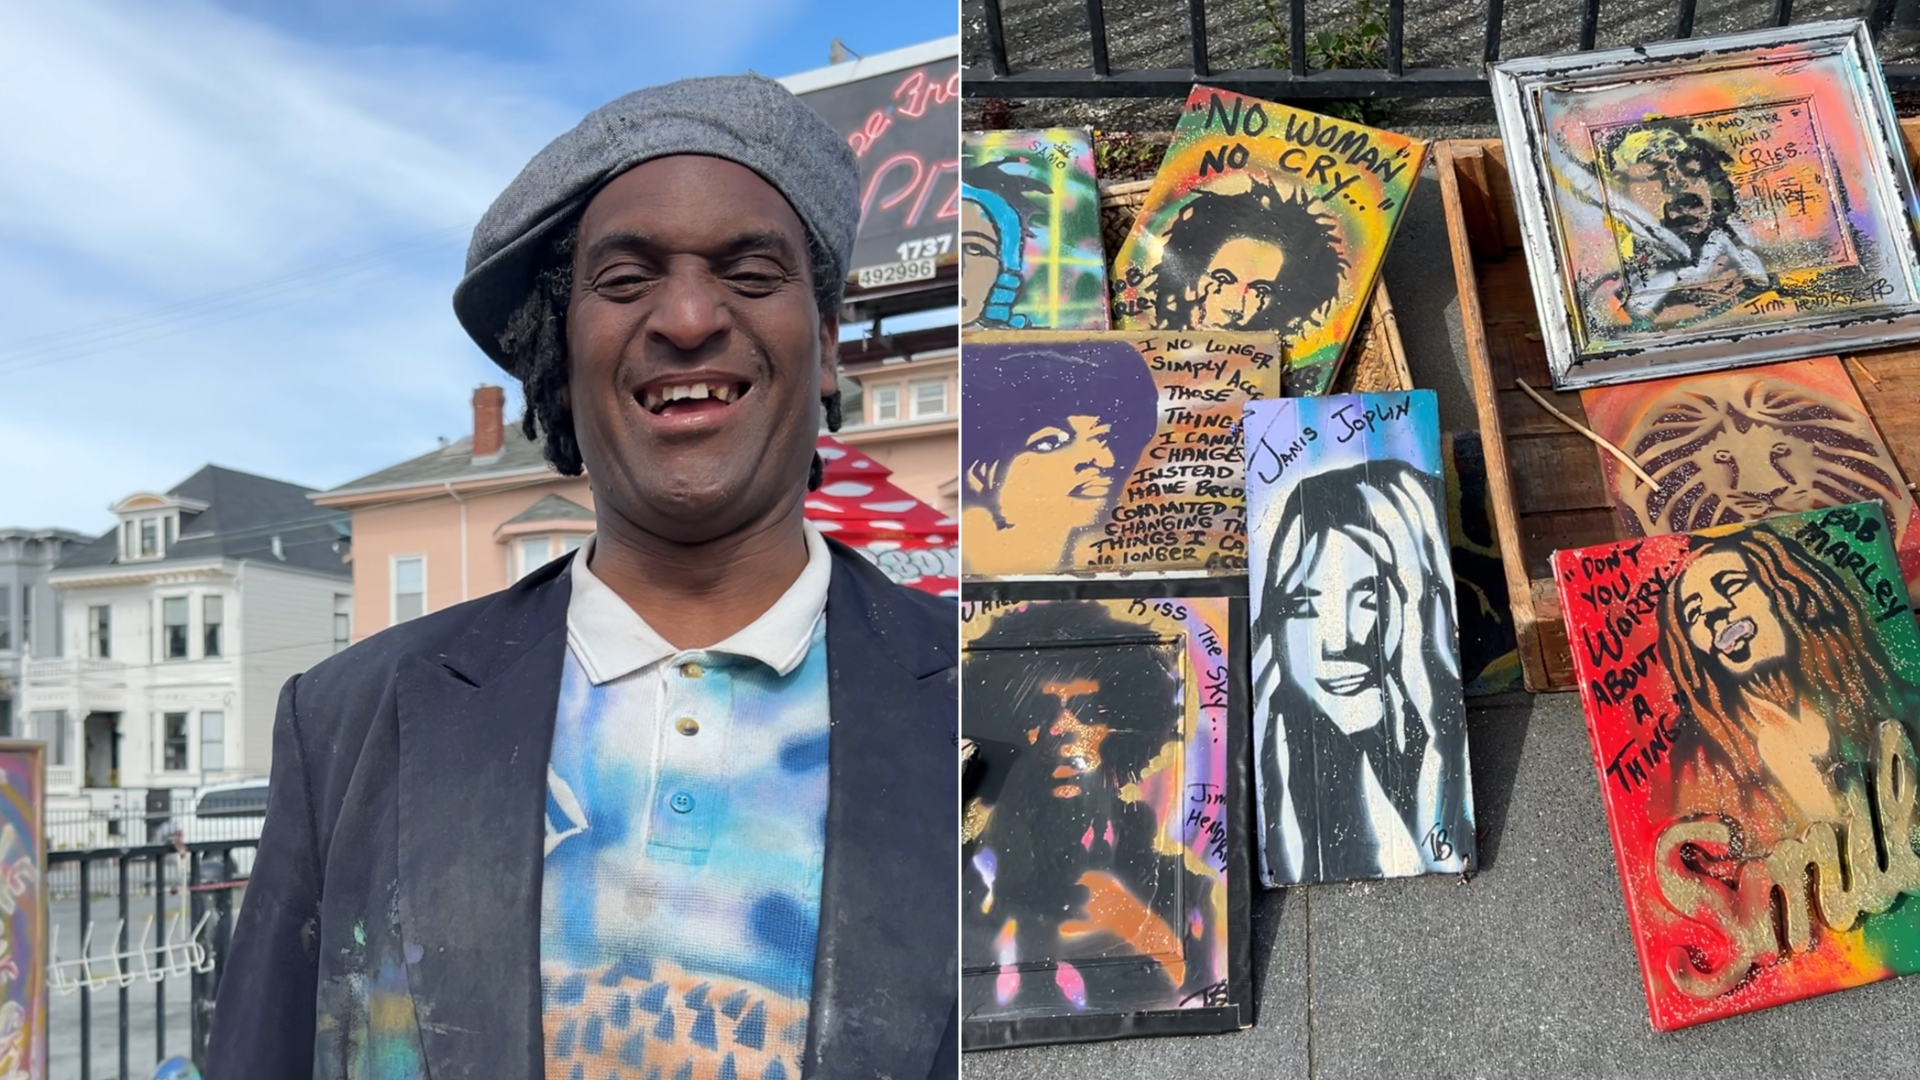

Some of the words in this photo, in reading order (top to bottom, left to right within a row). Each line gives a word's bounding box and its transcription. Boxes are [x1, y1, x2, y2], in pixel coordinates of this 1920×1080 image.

[1200, 143, 1249, 177] NO
[896, 234, 953, 261] 1737
[860, 260, 932, 286] 492996
[1138, 337, 1159, 353] I
[1166, 339, 1193, 352] NO
[1205, 339, 1274, 370] LONGER
[1150, 356, 1228, 380] SIMPLY
[1163, 385, 1234, 402] THOSE
[1159, 431, 1177, 445] I
[1131, 465, 1234, 485] INSTEAD
[1231, 505, 1246, 518] T
[1104, 515, 1214, 537] CHANGING
[1089, 532, 1180, 553] THINGS
[1186, 531, 1206, 547] I
[1581, 571, 1631, 613] YOU
[1592, 643, 1659, 715] ABOUT
[1632, 695, 1653, 725] A
